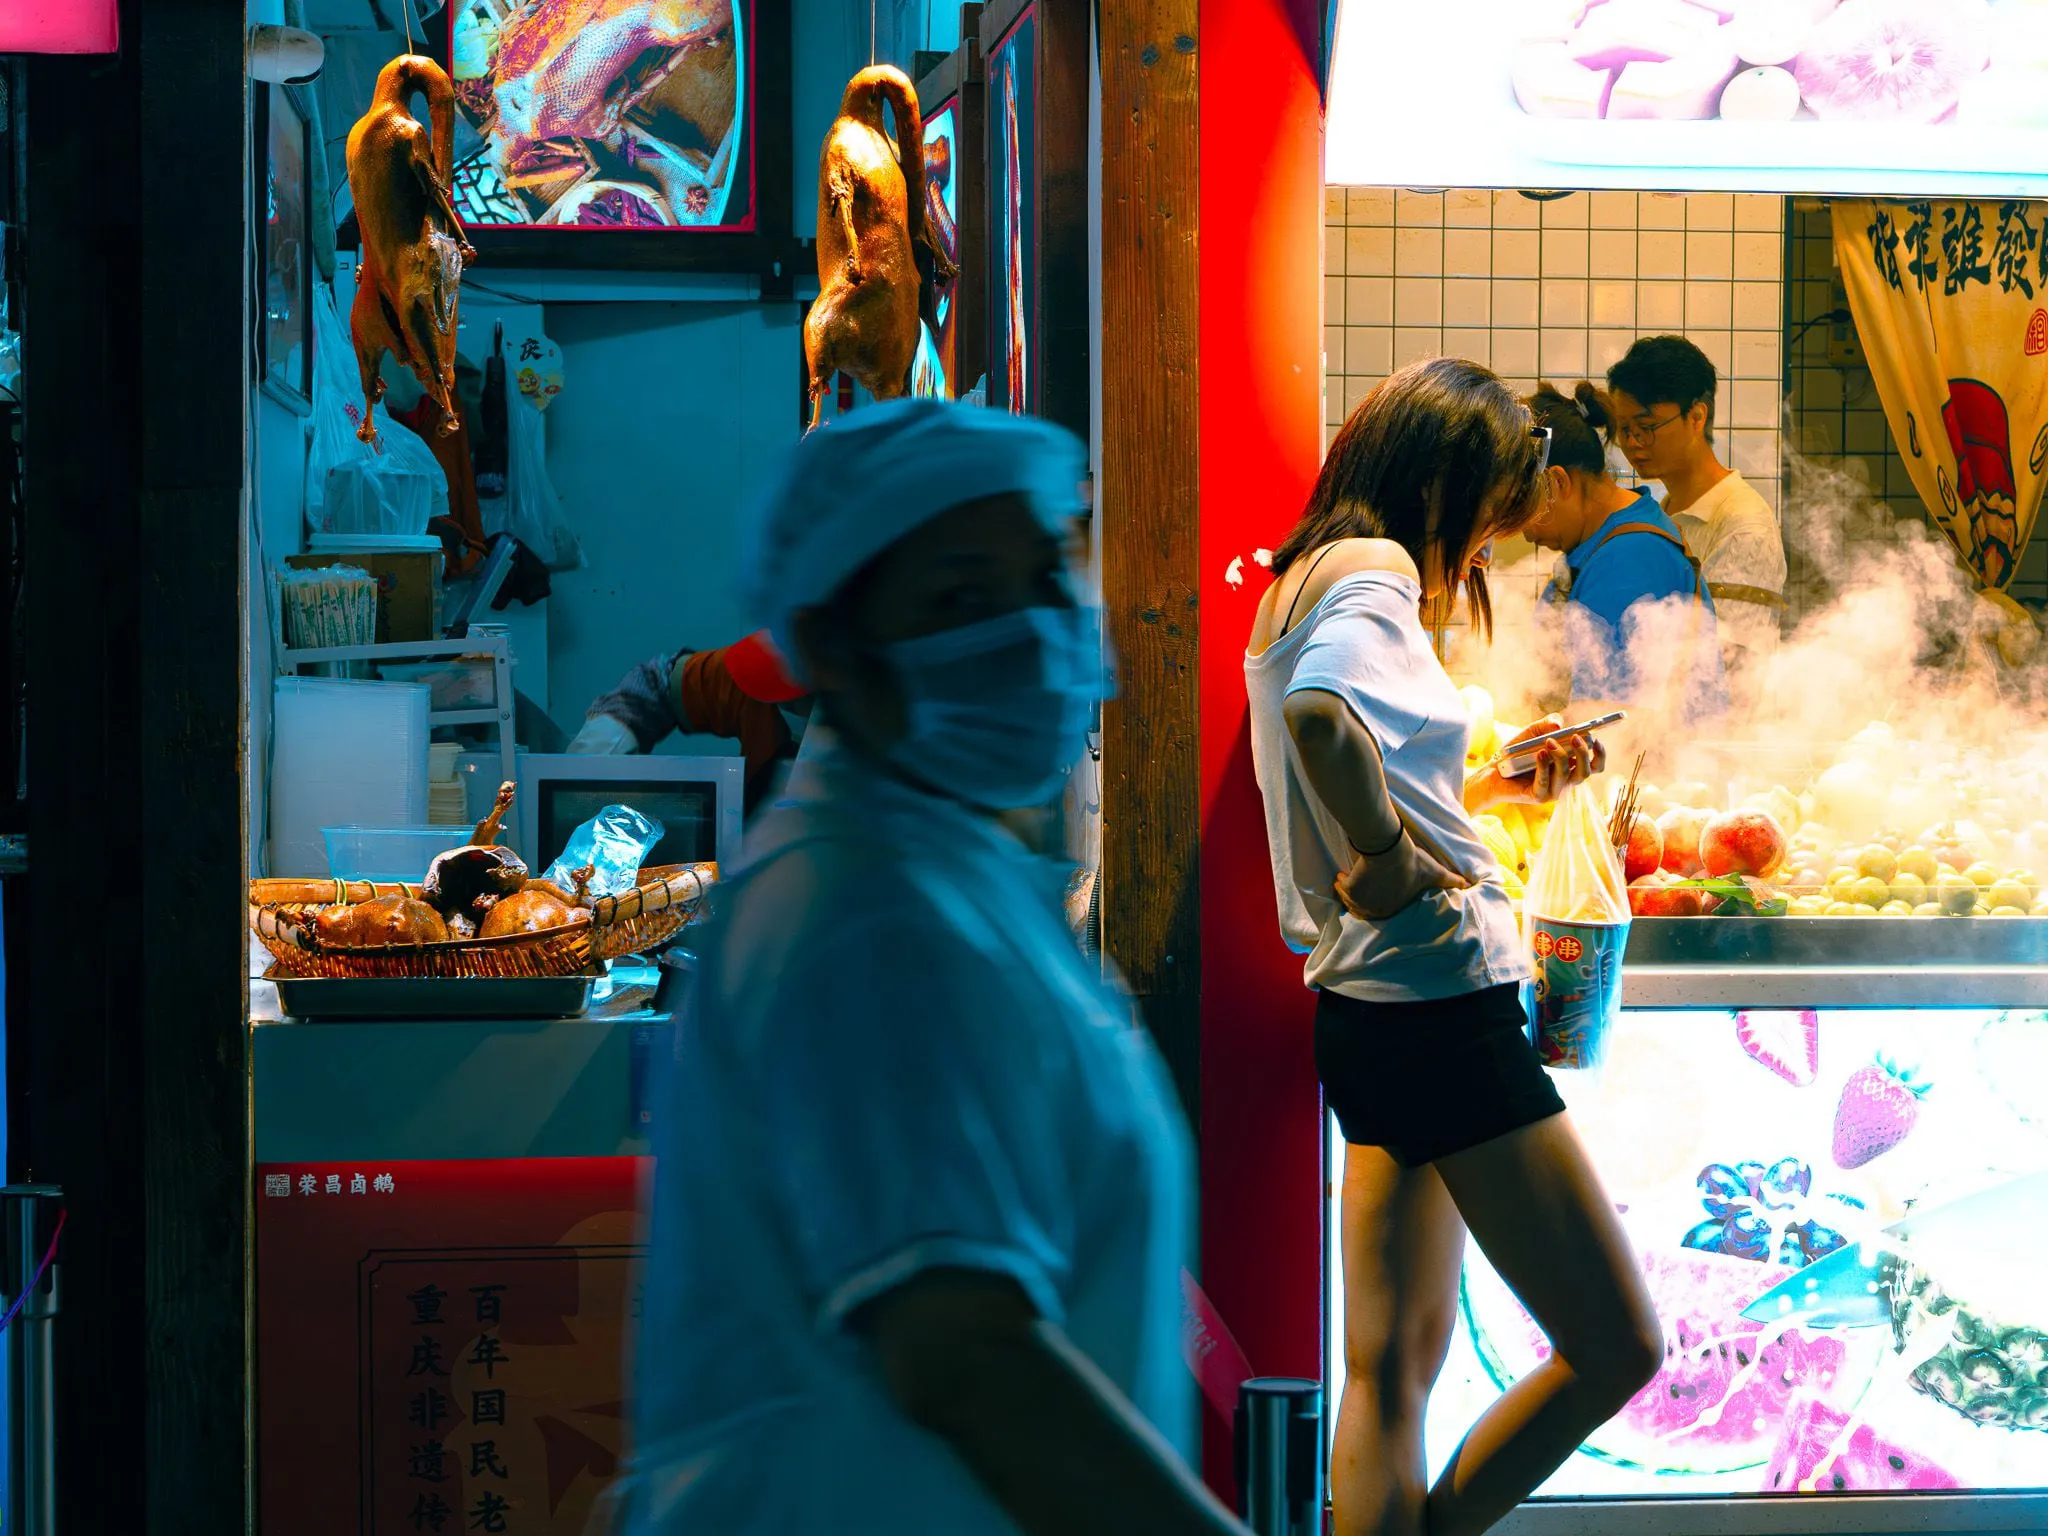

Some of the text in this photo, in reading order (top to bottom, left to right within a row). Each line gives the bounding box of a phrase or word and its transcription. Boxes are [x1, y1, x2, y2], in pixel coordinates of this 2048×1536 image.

[1536, 933, 1581, 962] 串串
[298, 1172, 396, 1196] 荣昌卤鹅
[406, 1283, 452, 1533] 重庆非遗传
[467, 1284, 510, 1533] 百年国民老
